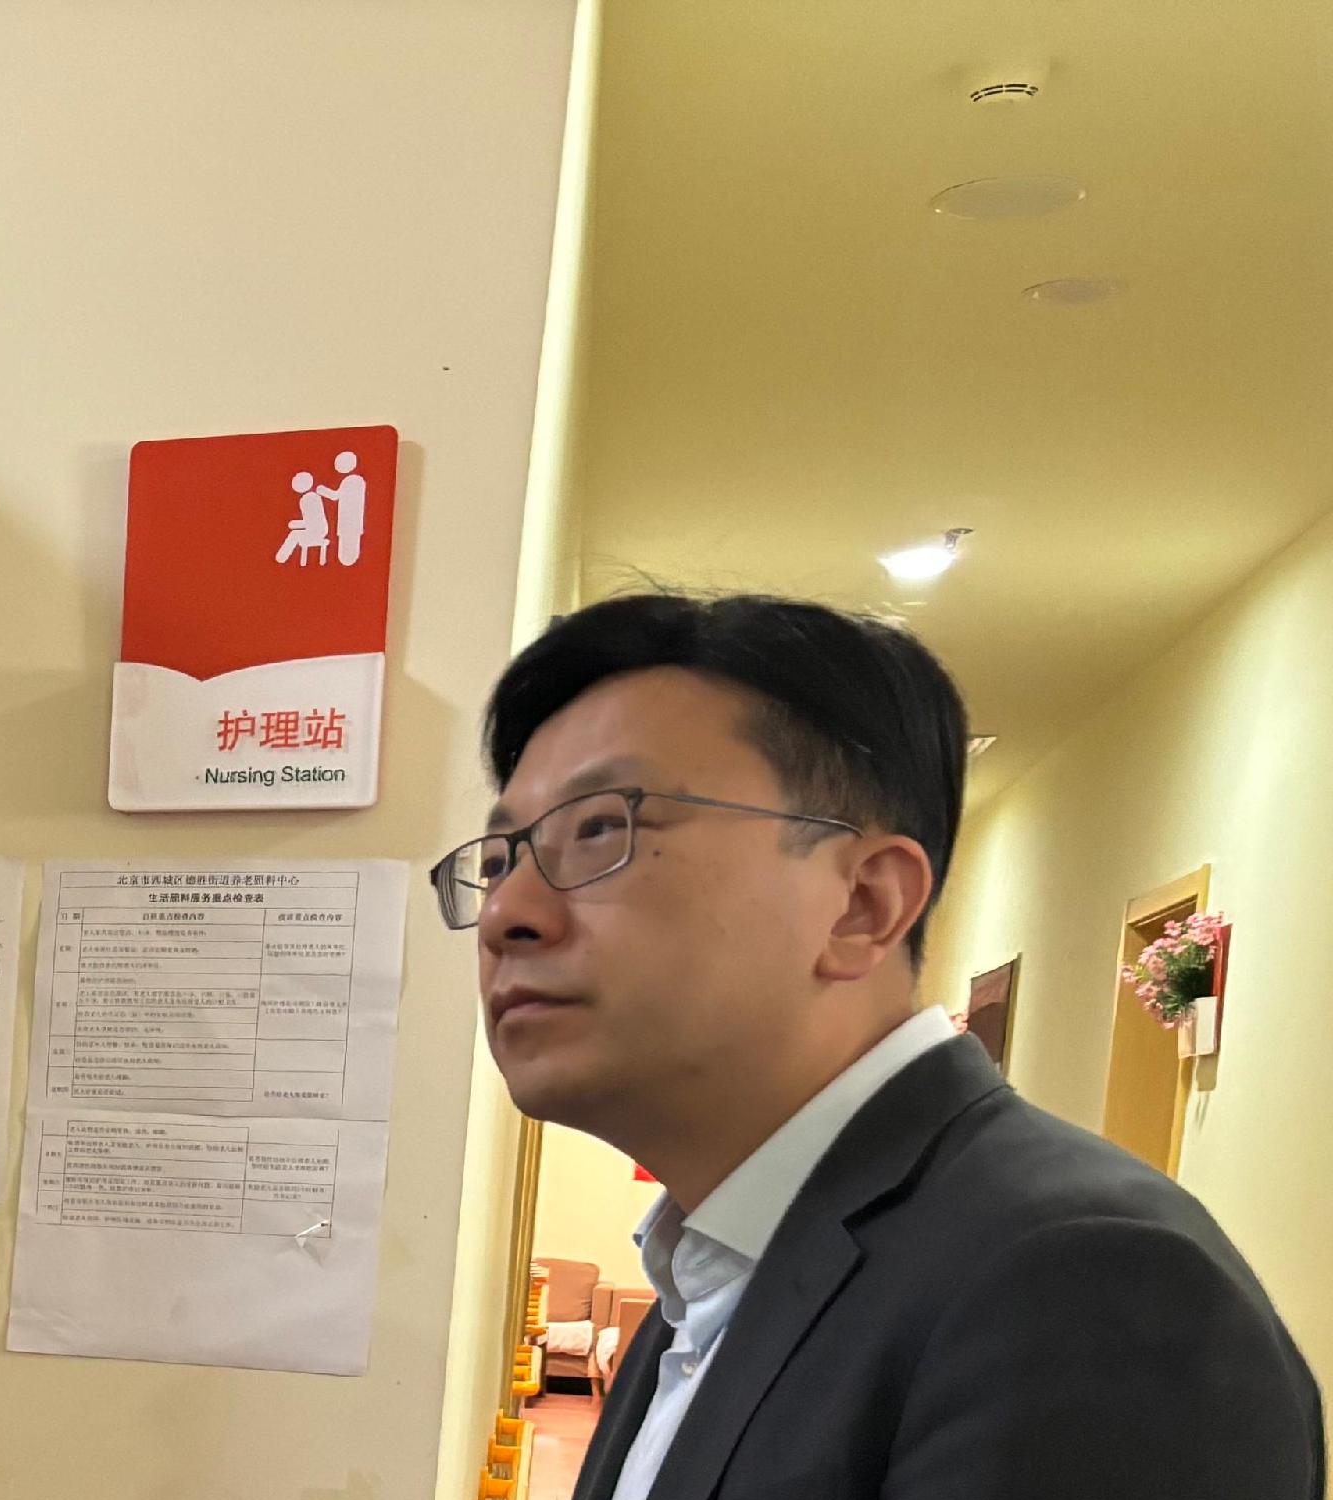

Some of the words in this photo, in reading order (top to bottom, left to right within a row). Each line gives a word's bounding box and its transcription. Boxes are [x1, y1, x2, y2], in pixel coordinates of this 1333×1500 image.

[217, 707, 346, 752] 护理站
[205, 766, 275, 785] Nursing
[281, 765, 345, 783] Station
